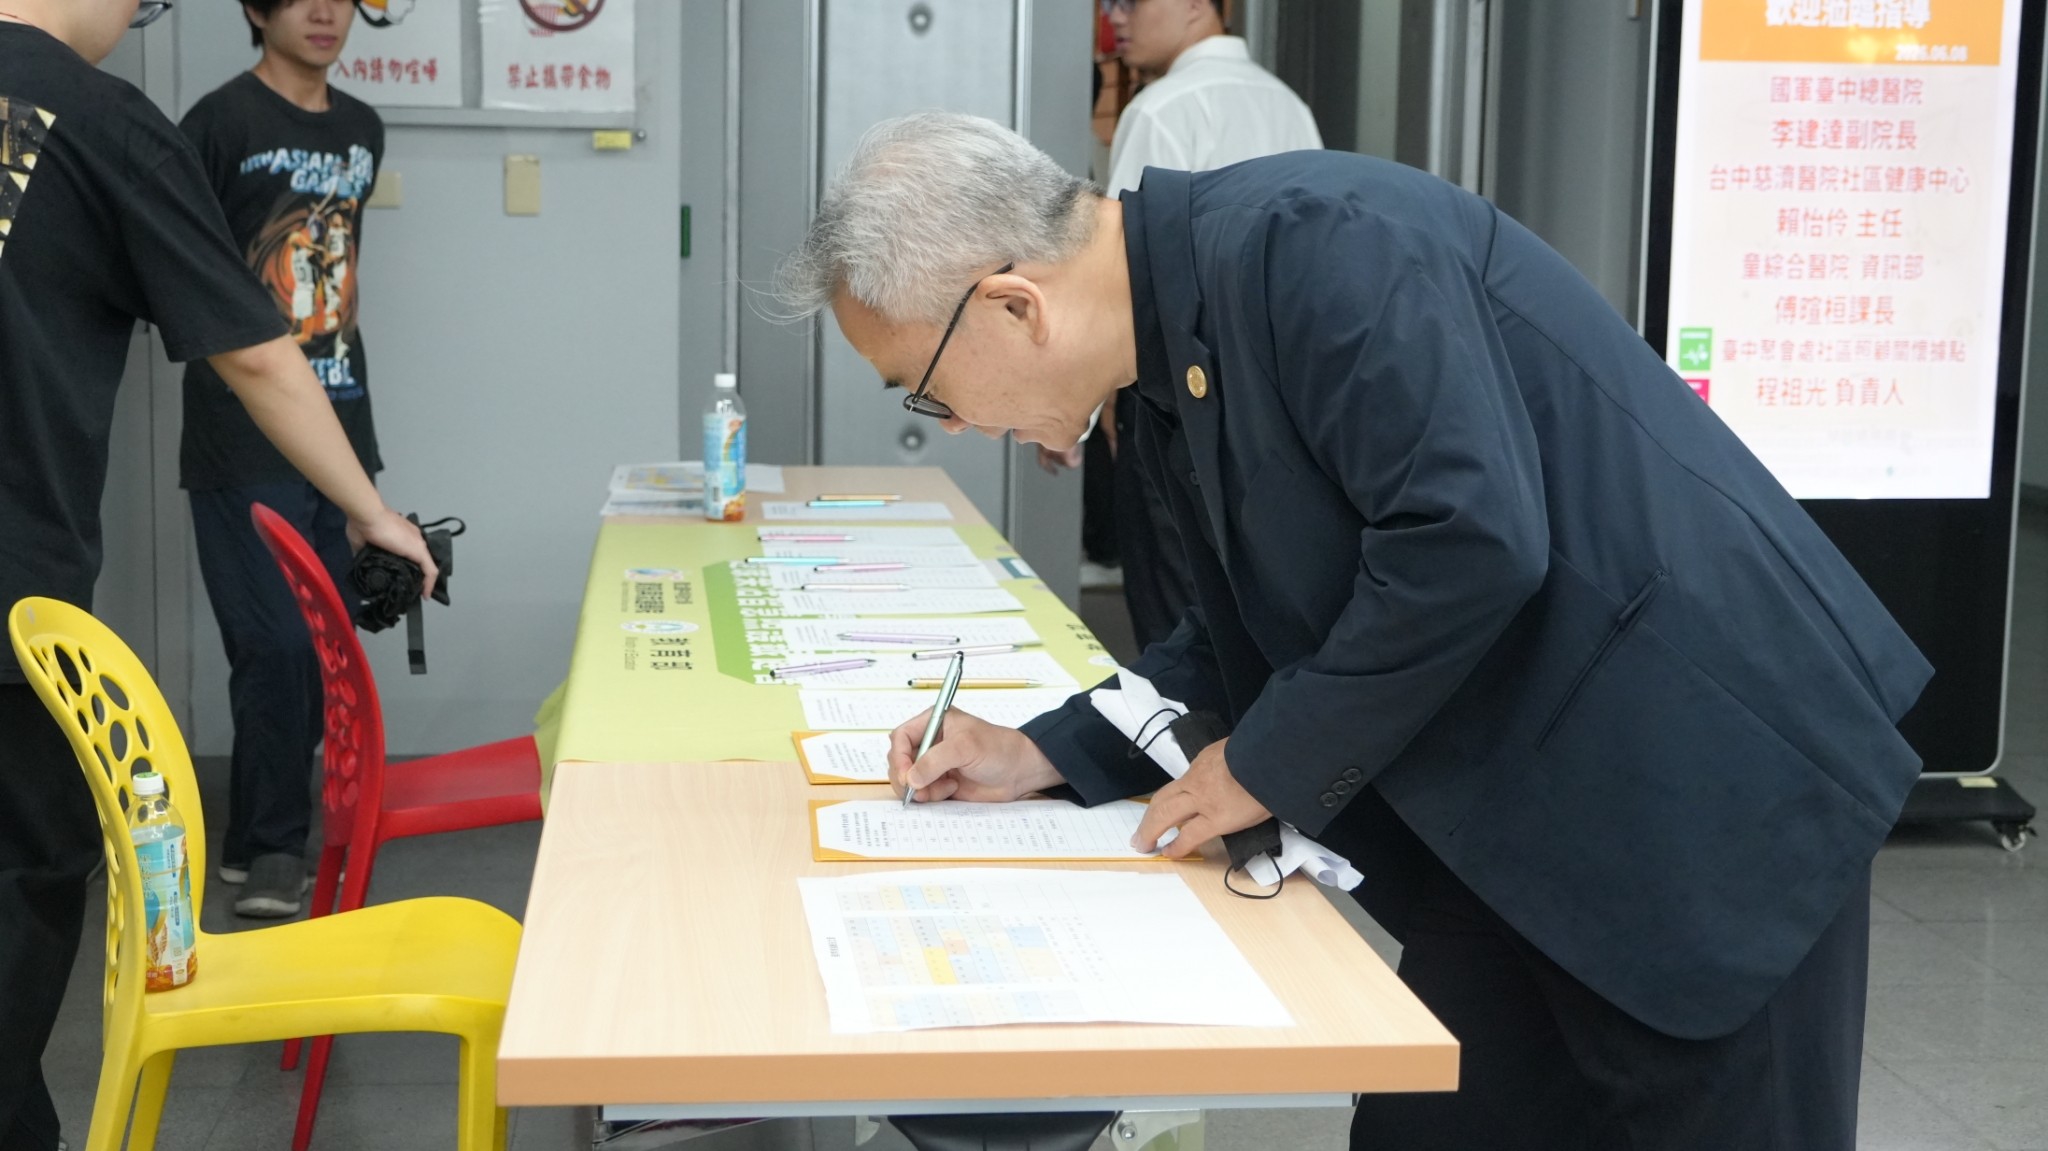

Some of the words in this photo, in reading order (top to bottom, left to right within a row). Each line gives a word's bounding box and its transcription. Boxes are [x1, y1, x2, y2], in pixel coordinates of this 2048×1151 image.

[1770, 76, 1923, 105] 國軍臺中總醫院
[1771, 119, 1917, 150] 李建達副院長
[1709, 164, 1969, 193] 台中慈濟醫院社區健康中心
[1856, 207, 1902, 238] 主任
[1743, 253, 1849, 280] 童綜合醫院
[1863, 254, 1924, 281] 資訊部
[1757, 377, 1828, 406] 程祖光
[1836, 377, 1905, 406] 負責人
